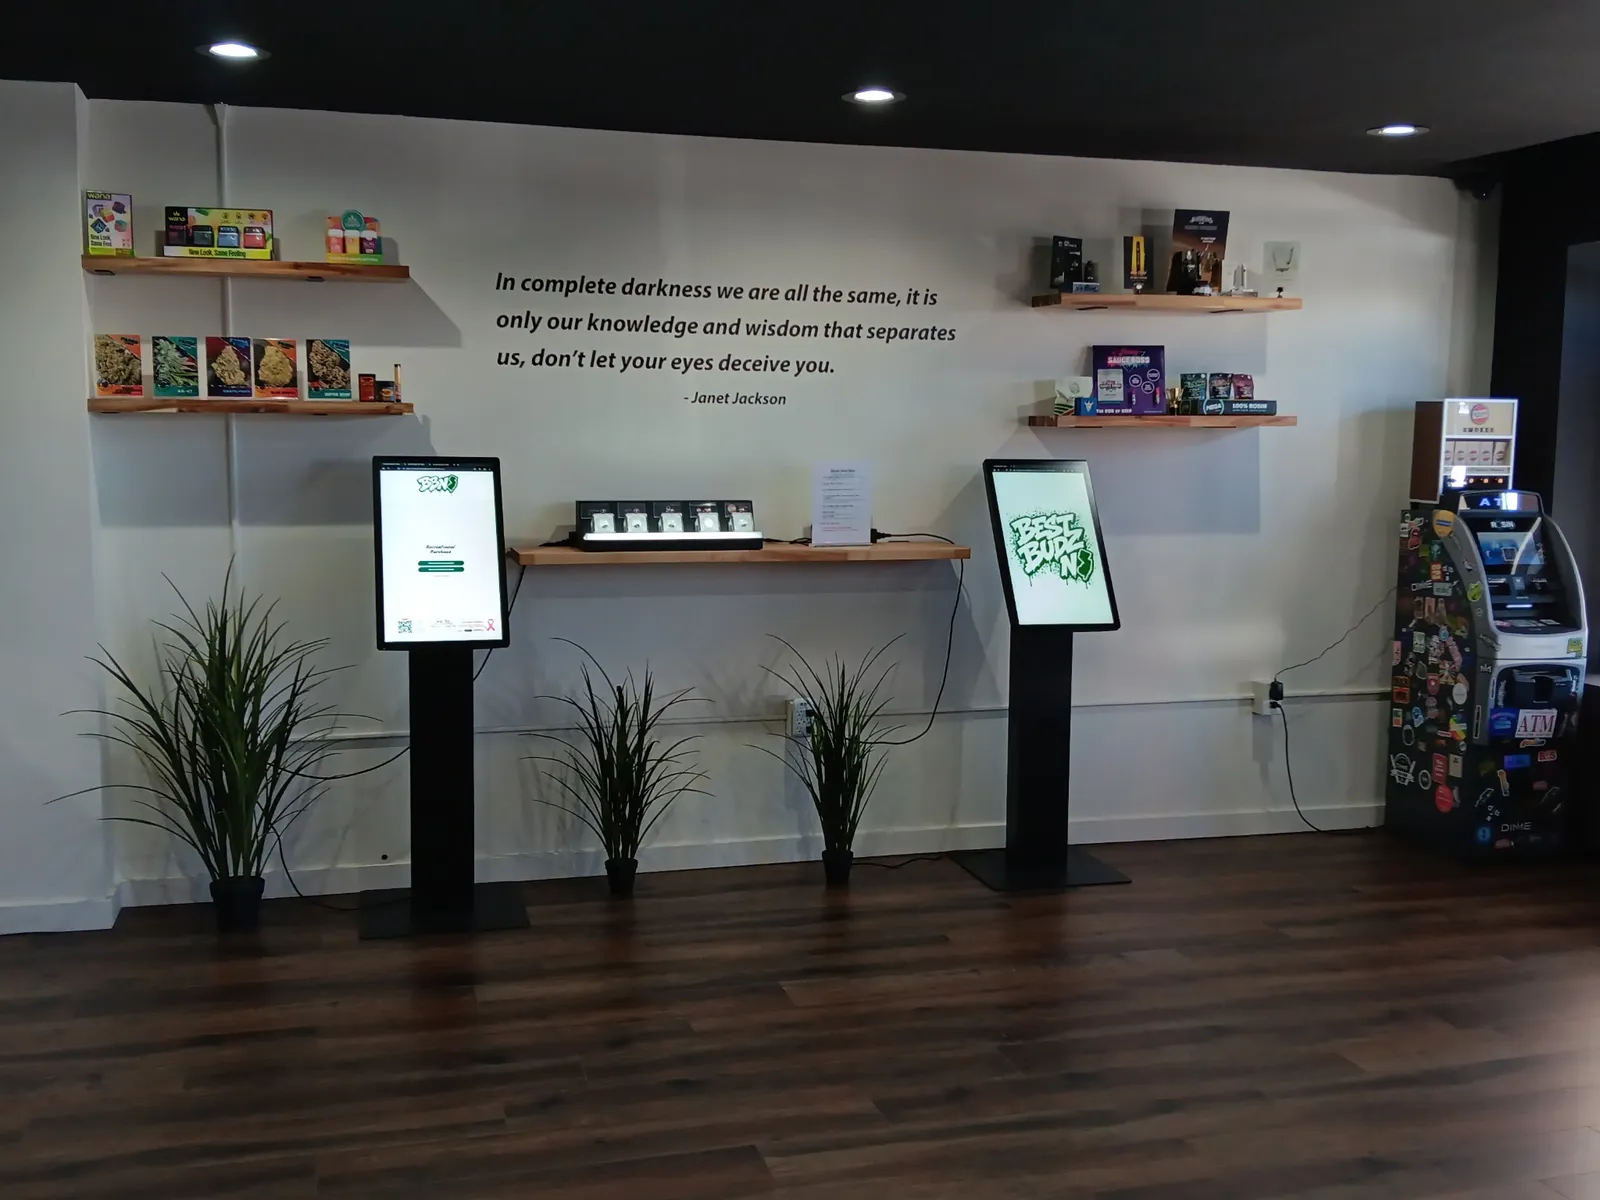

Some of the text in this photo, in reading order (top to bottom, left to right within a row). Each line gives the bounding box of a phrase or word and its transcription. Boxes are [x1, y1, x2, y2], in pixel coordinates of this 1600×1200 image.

[496, 272, 937, 307] In complete darkness we are all the same, it is
[497, 310, 956, 344] only our knowledge and wisdom that separates
[497, 348, 834, 377] us, don't let your eyes deceive you.
[691, 392, 730, 405] Janet
[732, 392, 787, 406] Jackson
[1010, 513, 1077, 546] BEST
[1518, 714, 1555, 732] ATM
